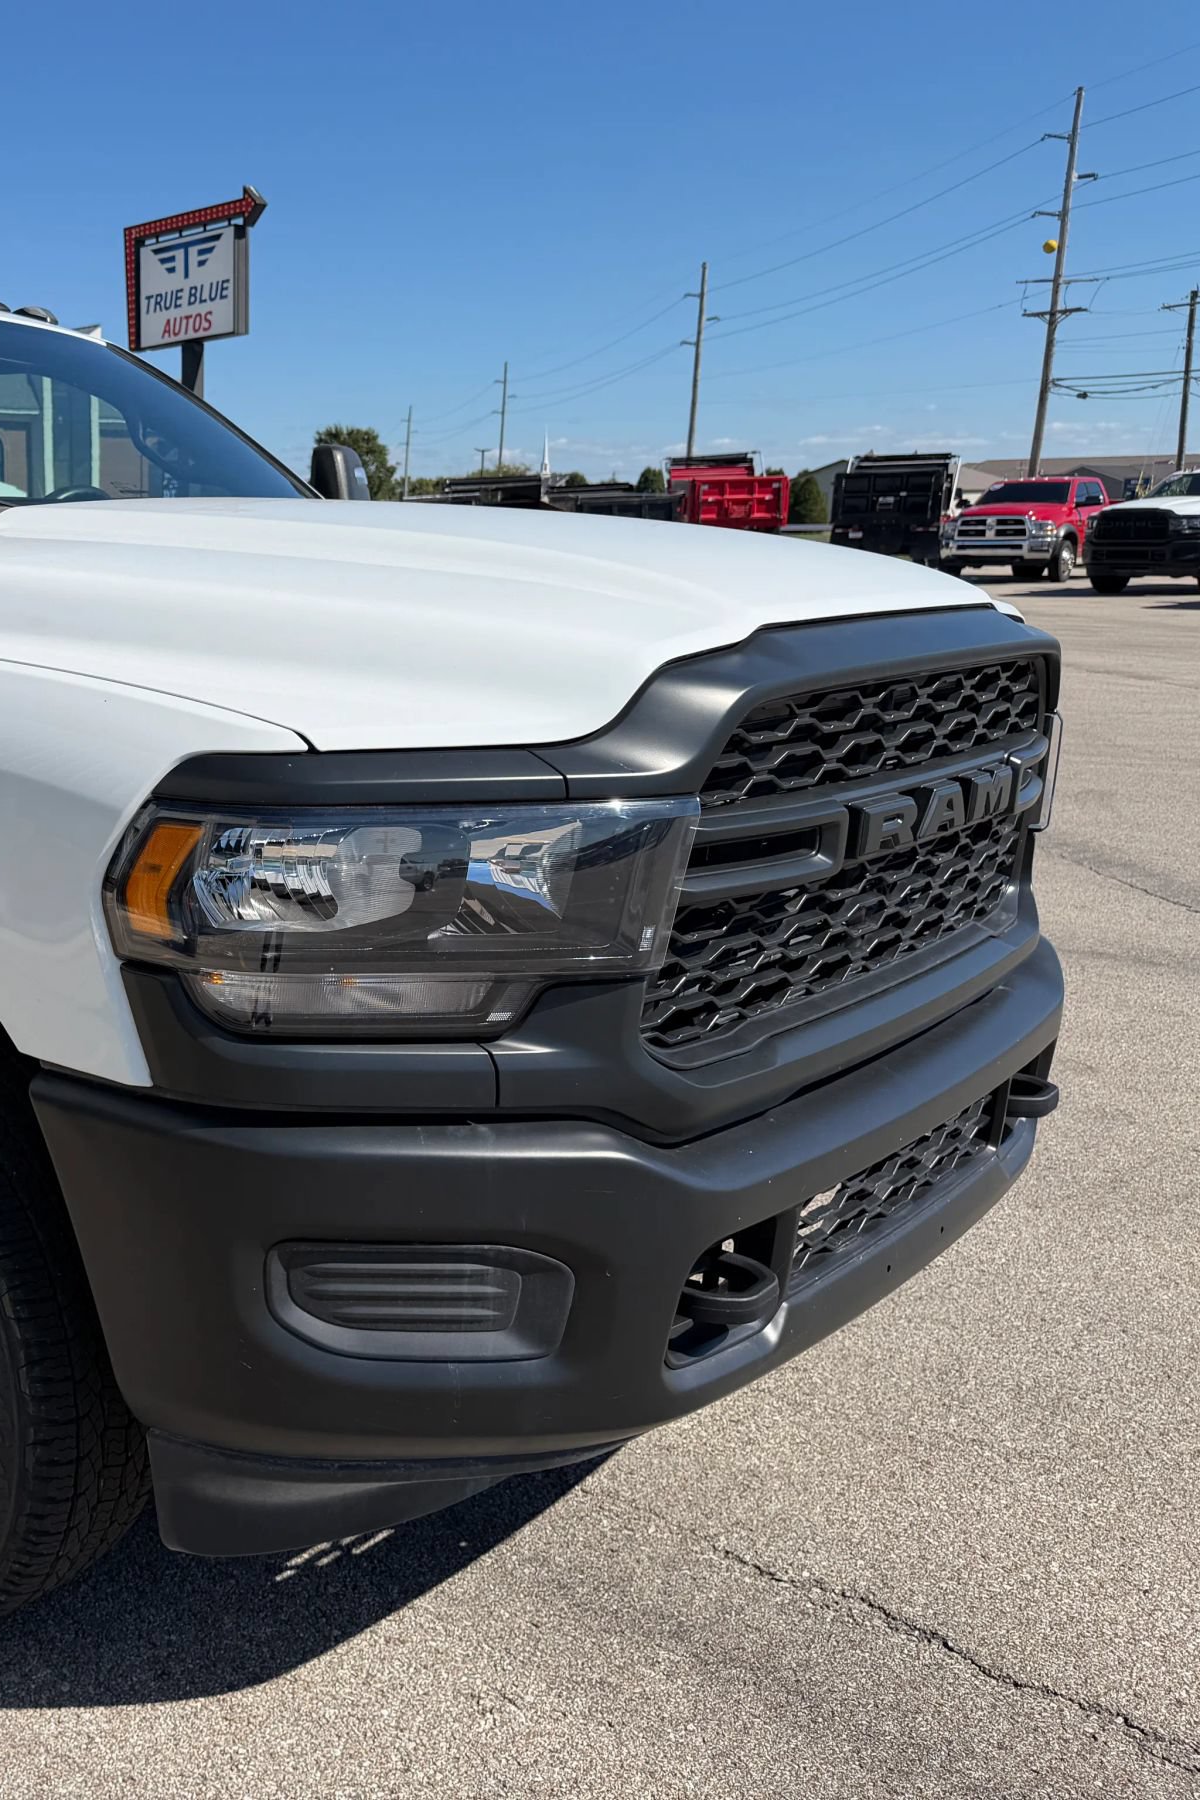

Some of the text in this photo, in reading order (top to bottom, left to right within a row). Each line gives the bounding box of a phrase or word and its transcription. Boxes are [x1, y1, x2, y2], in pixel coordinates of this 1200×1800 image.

[144, 279, 231, 316] TRUE BLUE
[161, 311, 213, 340] AUTOS
[859, 764, 1012, 857] RAM
